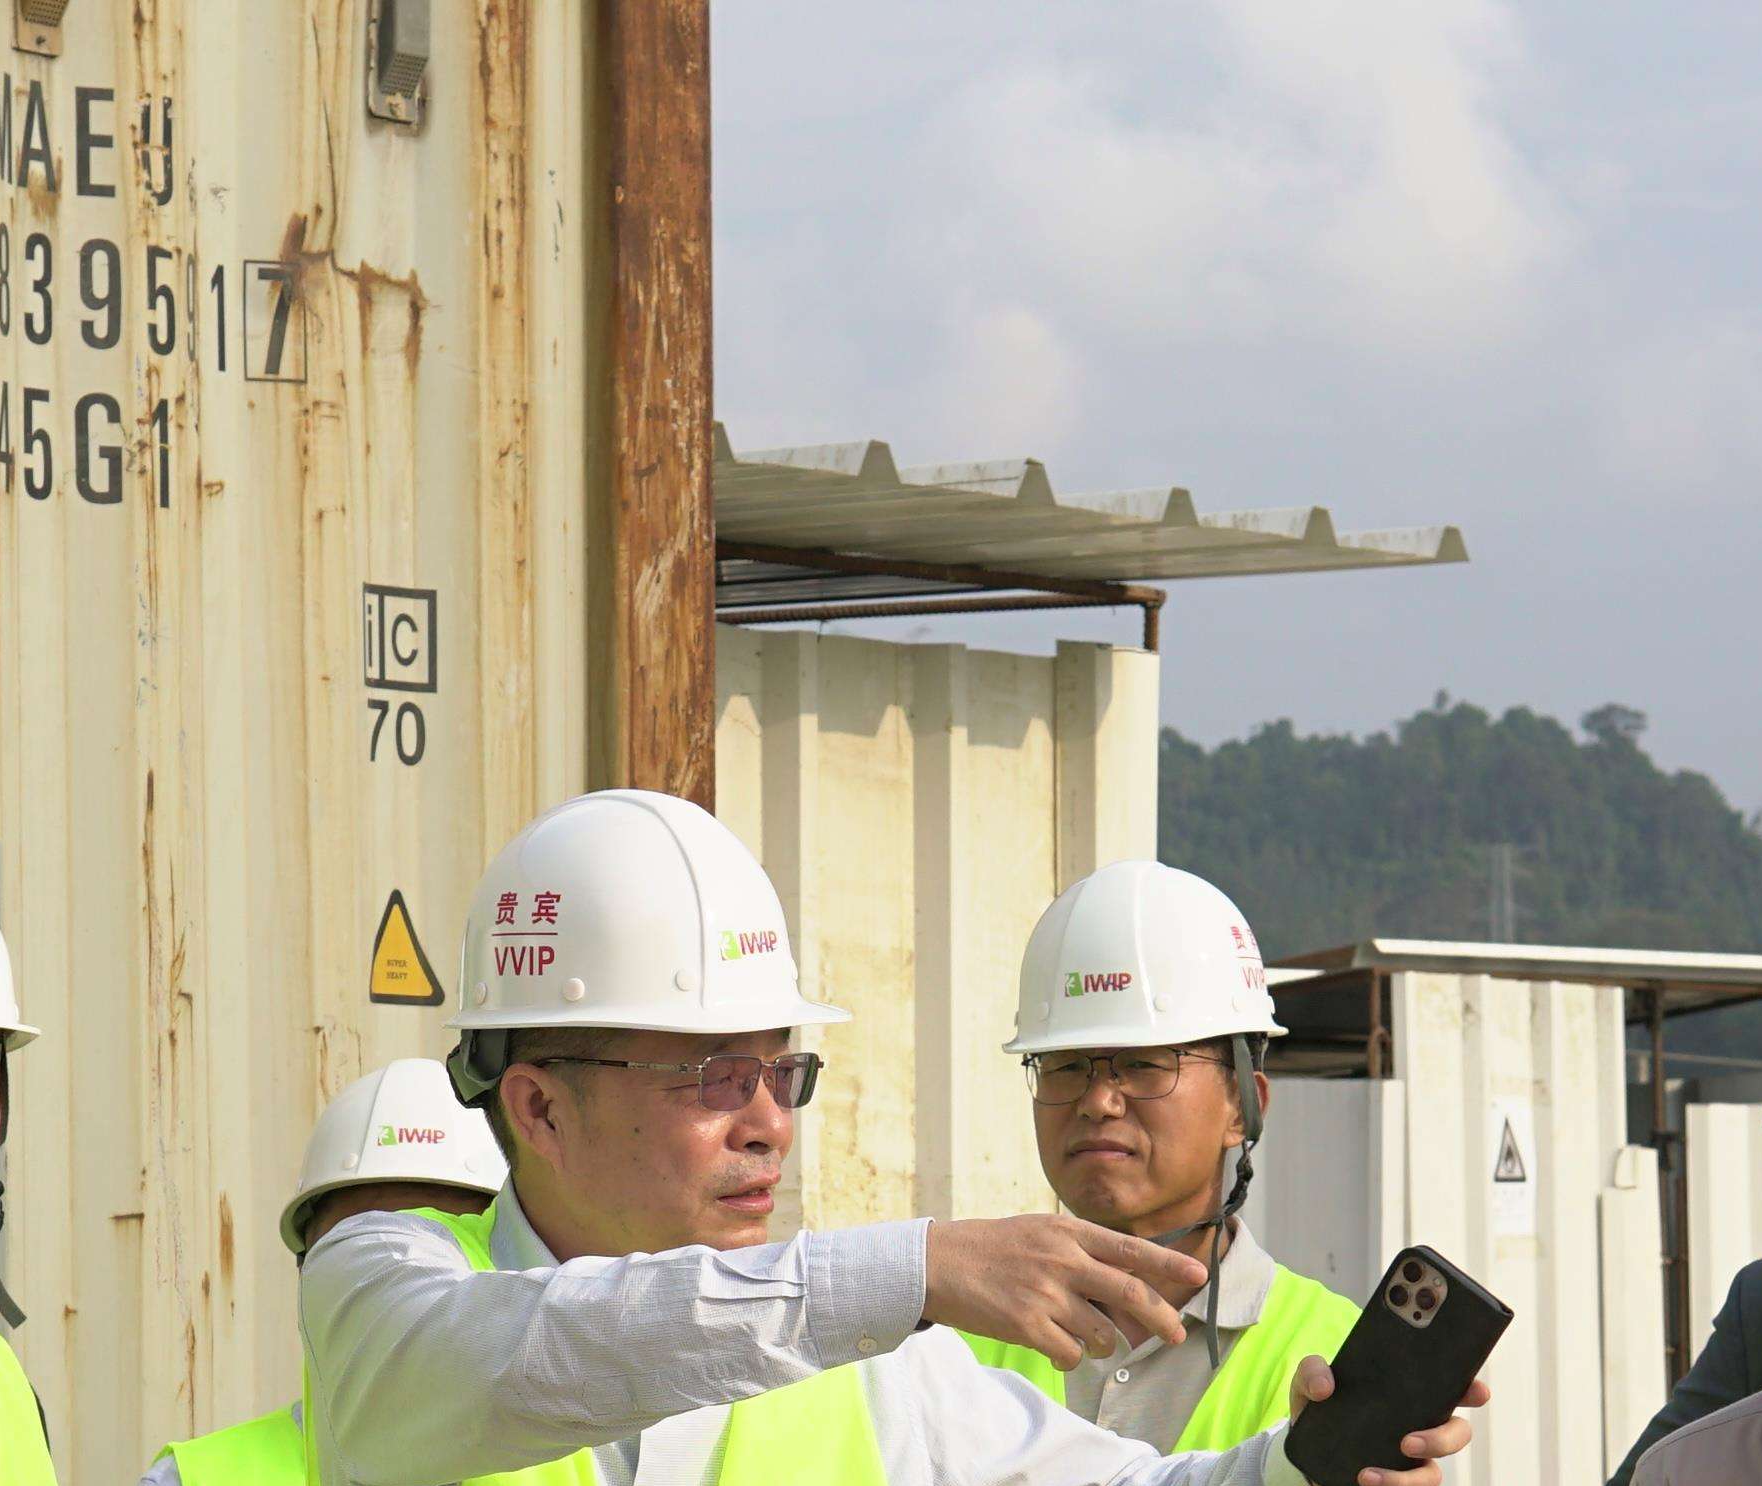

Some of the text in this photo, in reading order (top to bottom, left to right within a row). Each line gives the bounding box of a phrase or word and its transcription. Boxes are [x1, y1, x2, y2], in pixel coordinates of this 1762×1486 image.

[366, 699, 425, 767] 70
[494, 891, 562, 925] 贵宾
[739, 930, 777, 955] IWIP
[494, 946, 555, 976] VVIP
[1084, 972, 1132, 993] IWIP
[398, 1128, 446, 1144] IWIP
